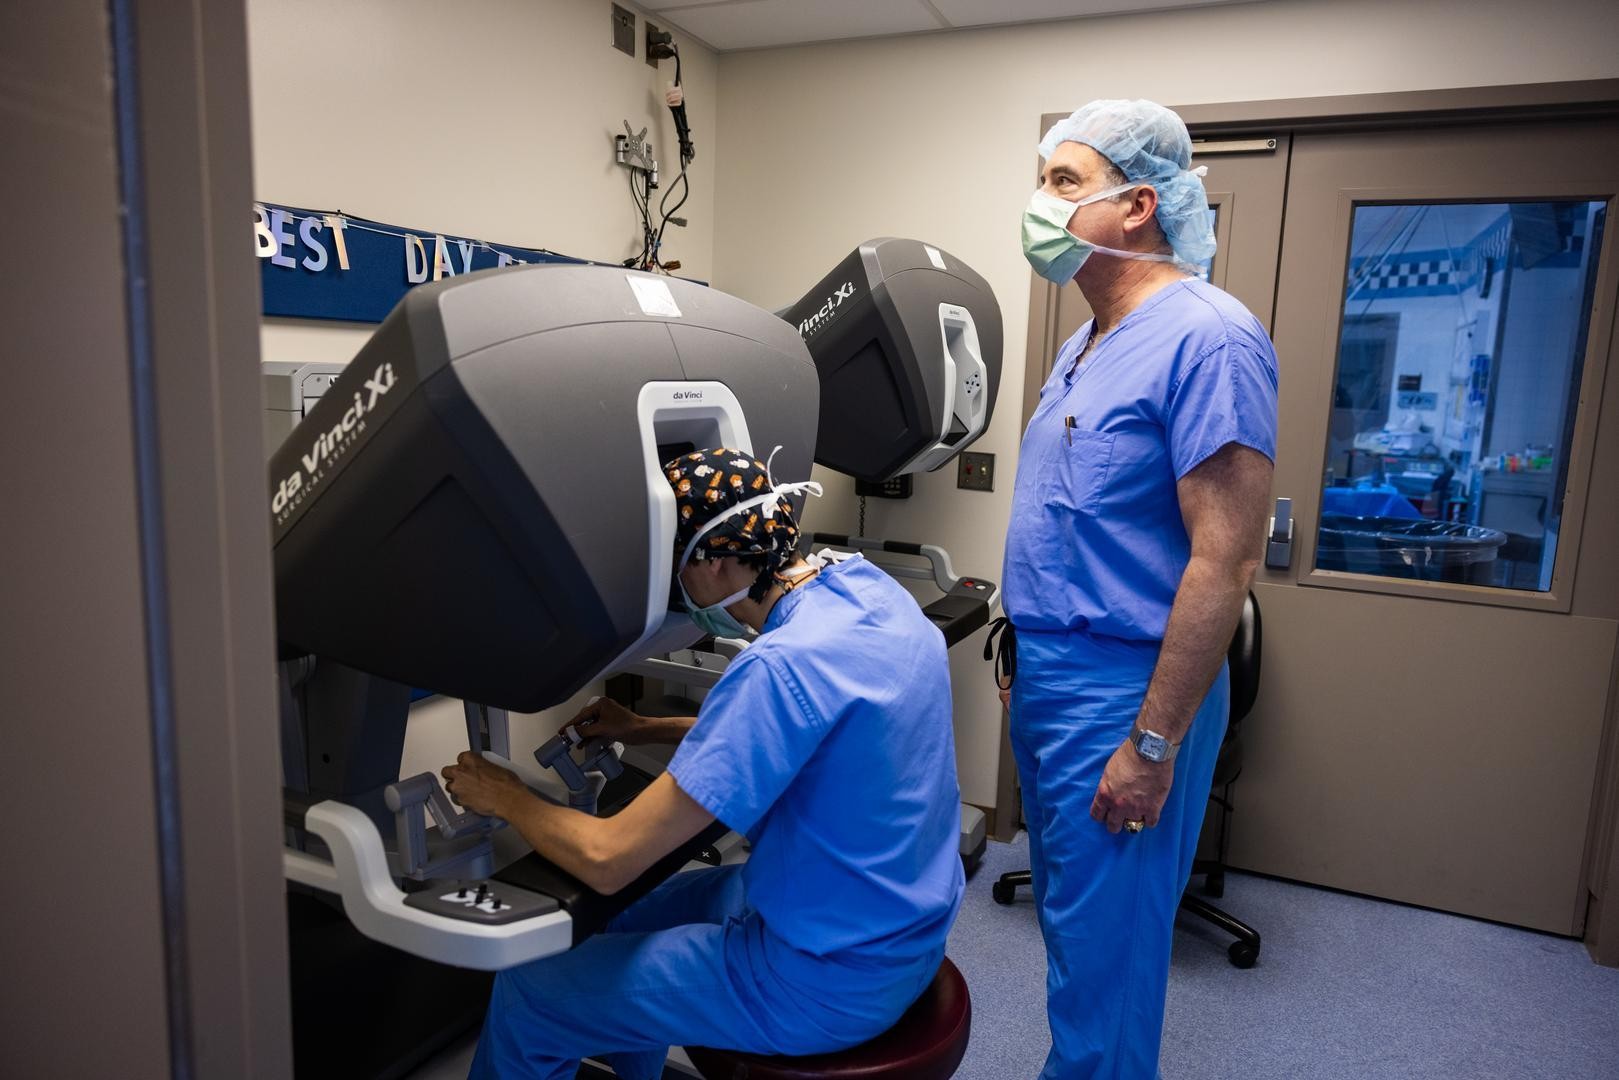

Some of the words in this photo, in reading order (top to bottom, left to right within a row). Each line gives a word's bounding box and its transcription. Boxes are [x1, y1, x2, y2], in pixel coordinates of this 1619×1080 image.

[253, 203, 350, 272] BEST
[405, 233, 474, 283] DAY
[834, 282, 855, 307] Xi
[810, 311, 836, 336] SYSTEM
[673, 391, 683, 399] da
[684, 390, 703, 399] Vinci
[272, 471, 303, 514] da
[302, 391, 364, 474] Vinci
[364, 362, 396, 412] Xi
[277, 470, 325, 526] SURGICAL
[327, 420, 368, 468] SYSTEM
